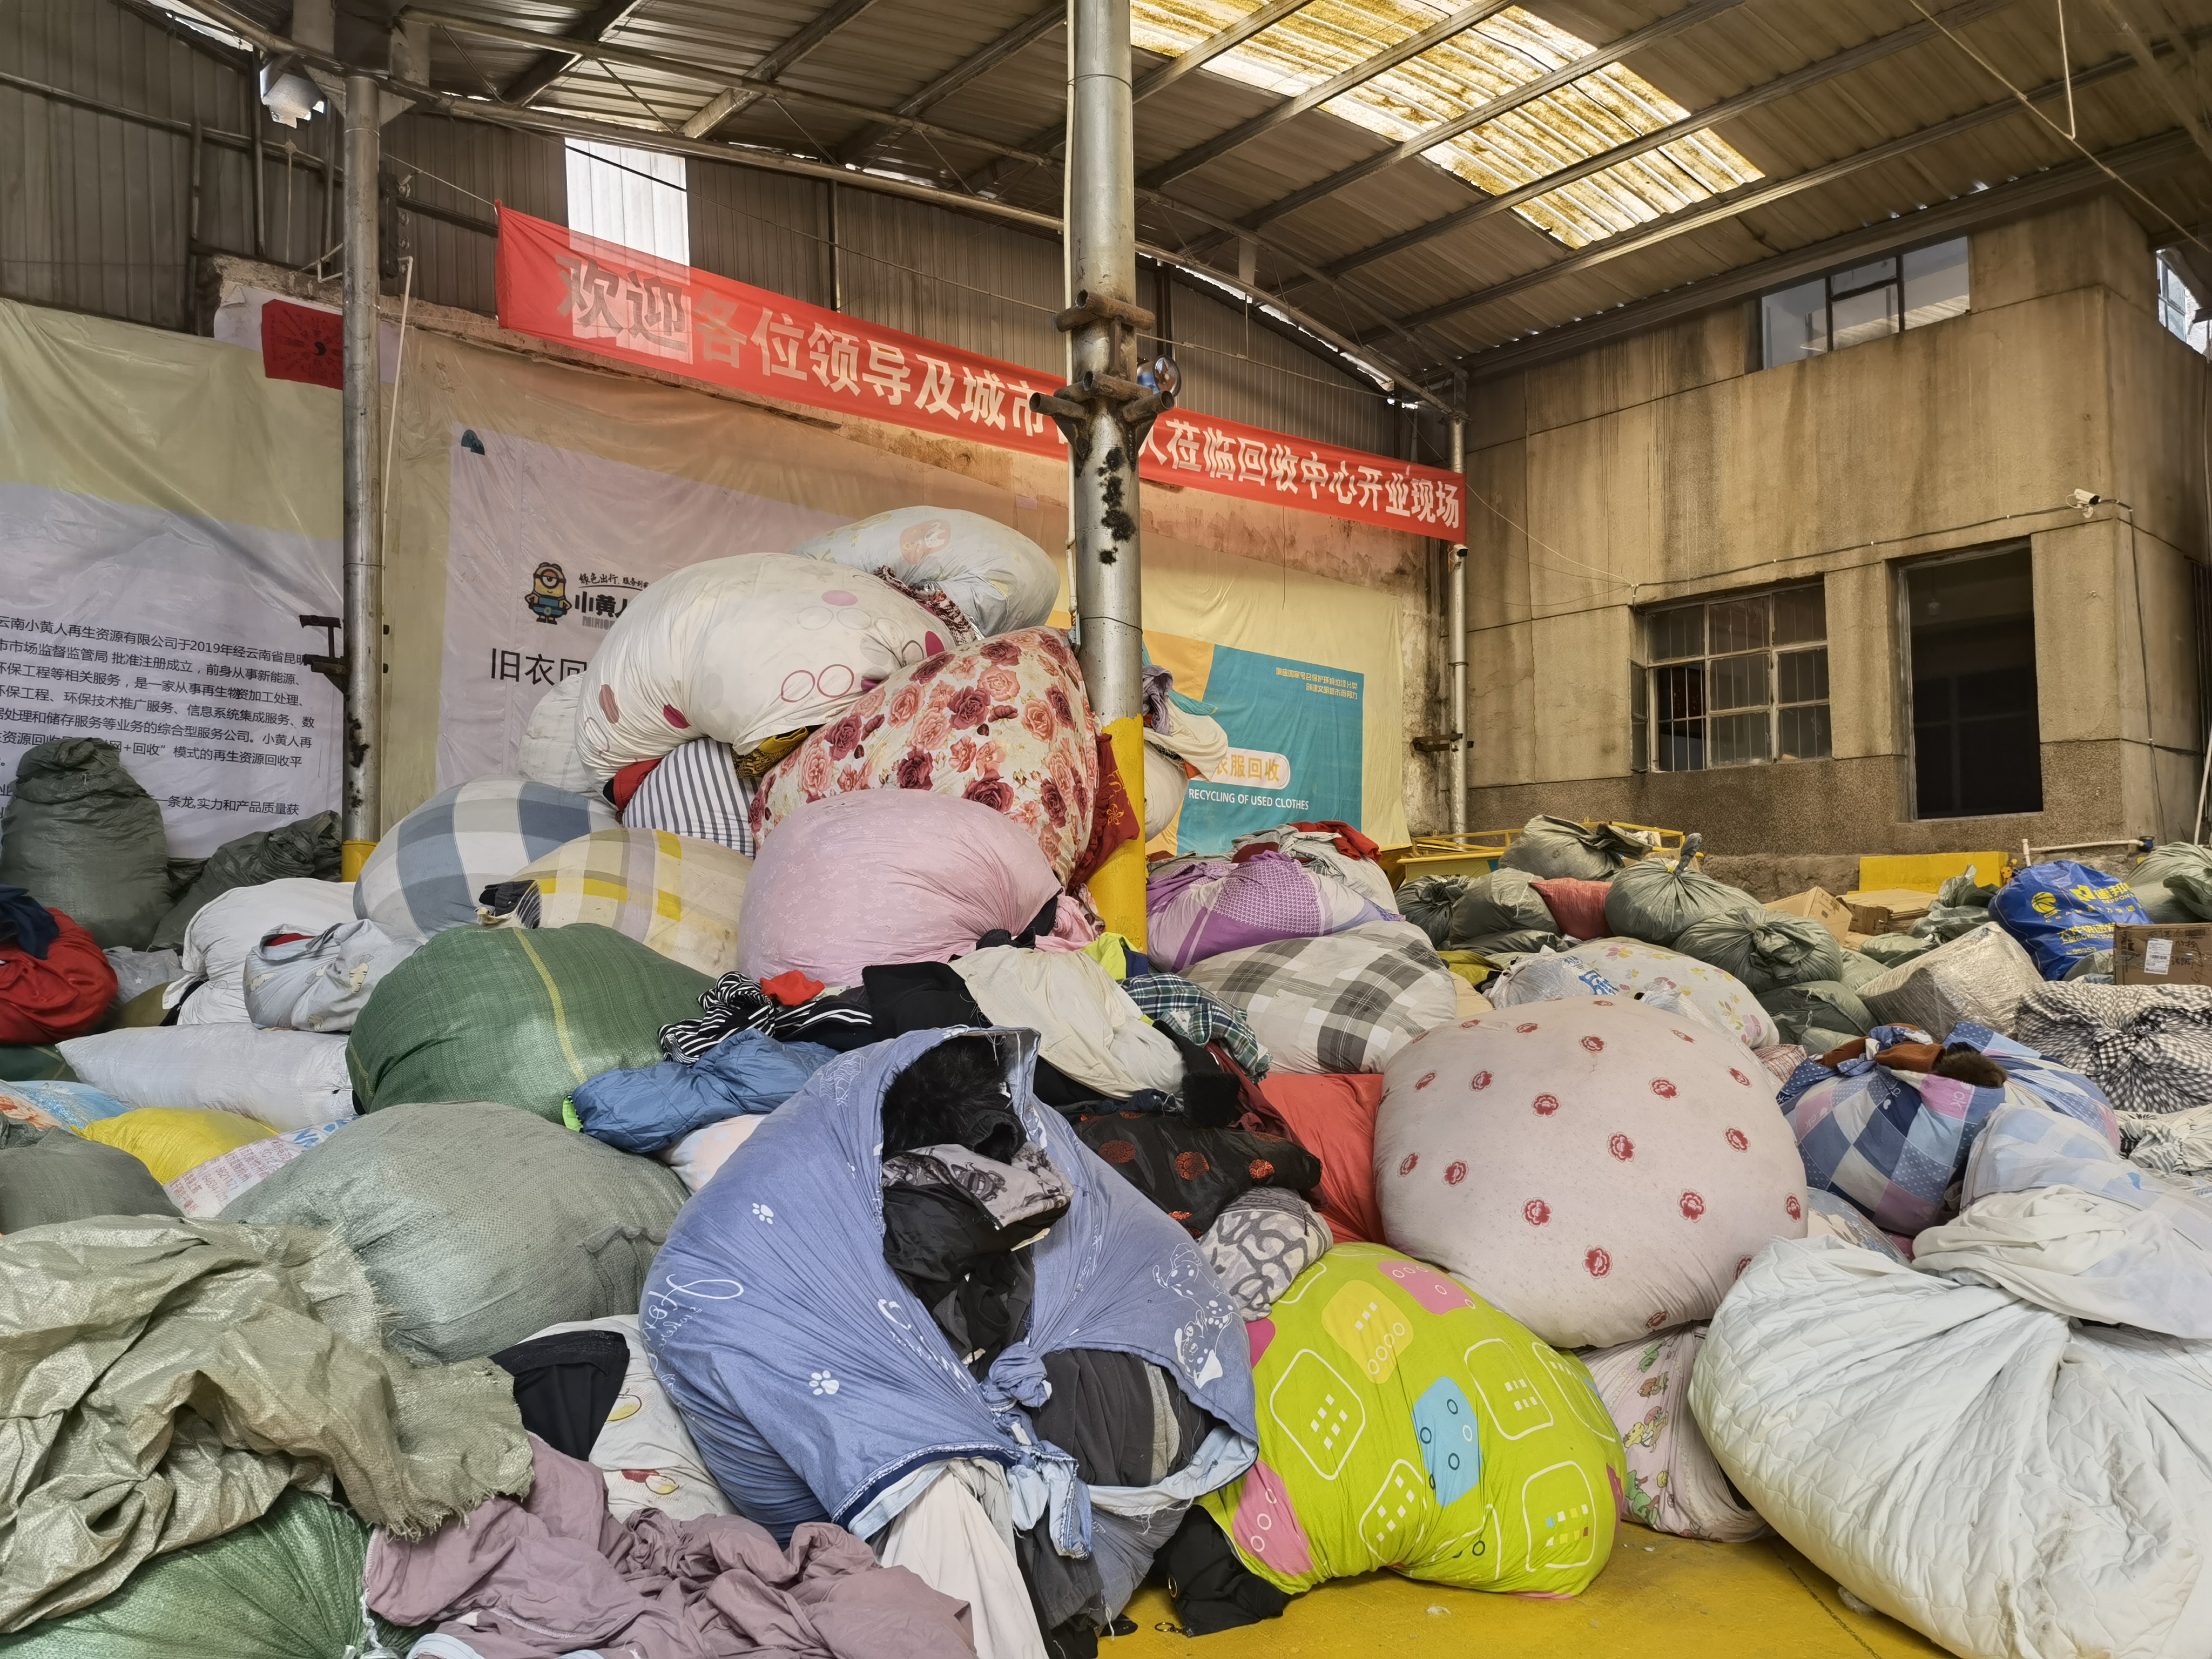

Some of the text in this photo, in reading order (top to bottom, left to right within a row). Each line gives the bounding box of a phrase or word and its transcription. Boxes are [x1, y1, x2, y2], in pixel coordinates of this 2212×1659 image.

[554, 253, 1460, 529] 欢迎各位领导及城市人莅临回收中心开业现场
[1189, 788, 1309, 811] RECYCLING OF USED CLOTHES
